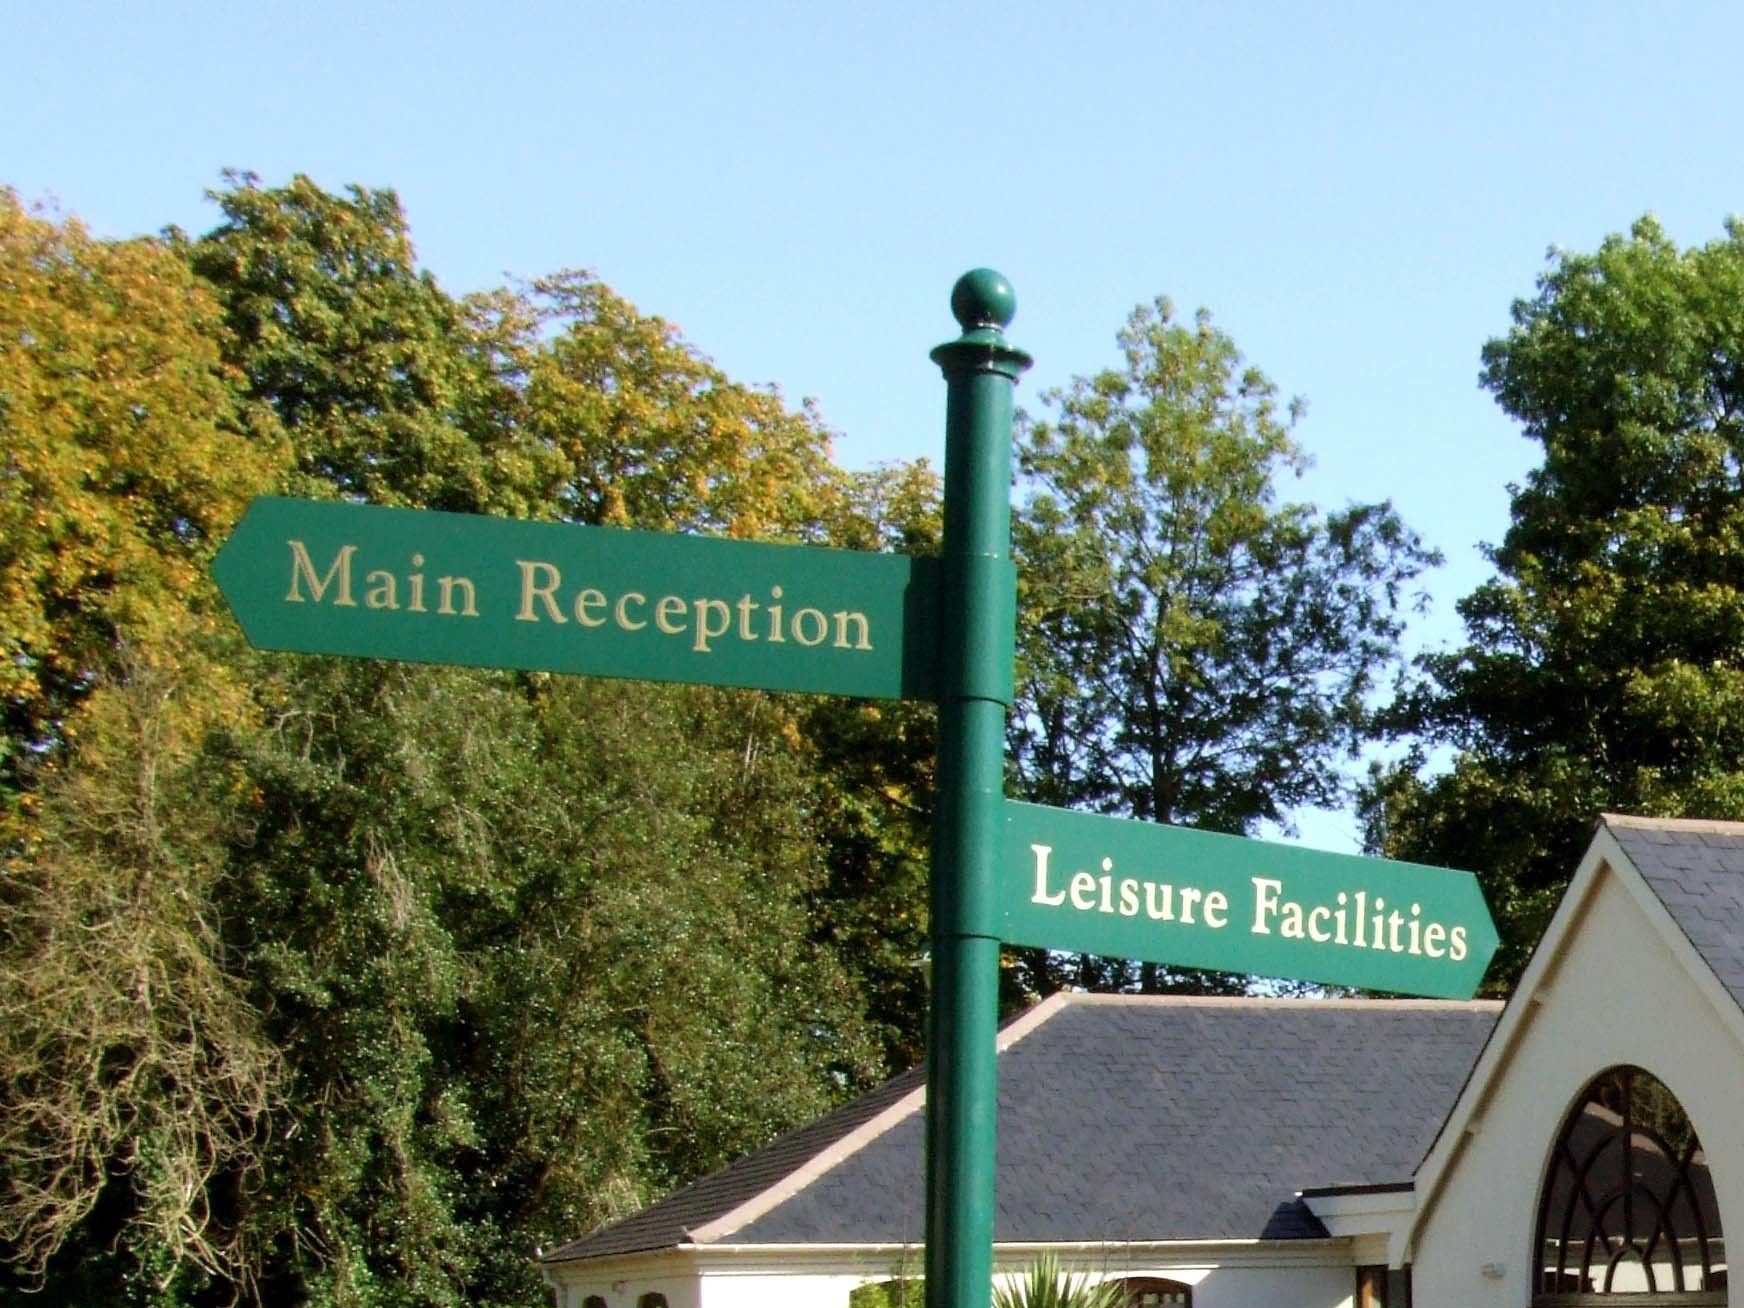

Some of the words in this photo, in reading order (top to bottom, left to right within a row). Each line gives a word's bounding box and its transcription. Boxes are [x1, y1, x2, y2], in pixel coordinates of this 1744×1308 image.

[285, 540, 480, 616] Main
[515, 560, 874, 653] Reception
[1030, 842, 1229, 929] Leisure
[1250, 876, 1468, 962] Facilities
